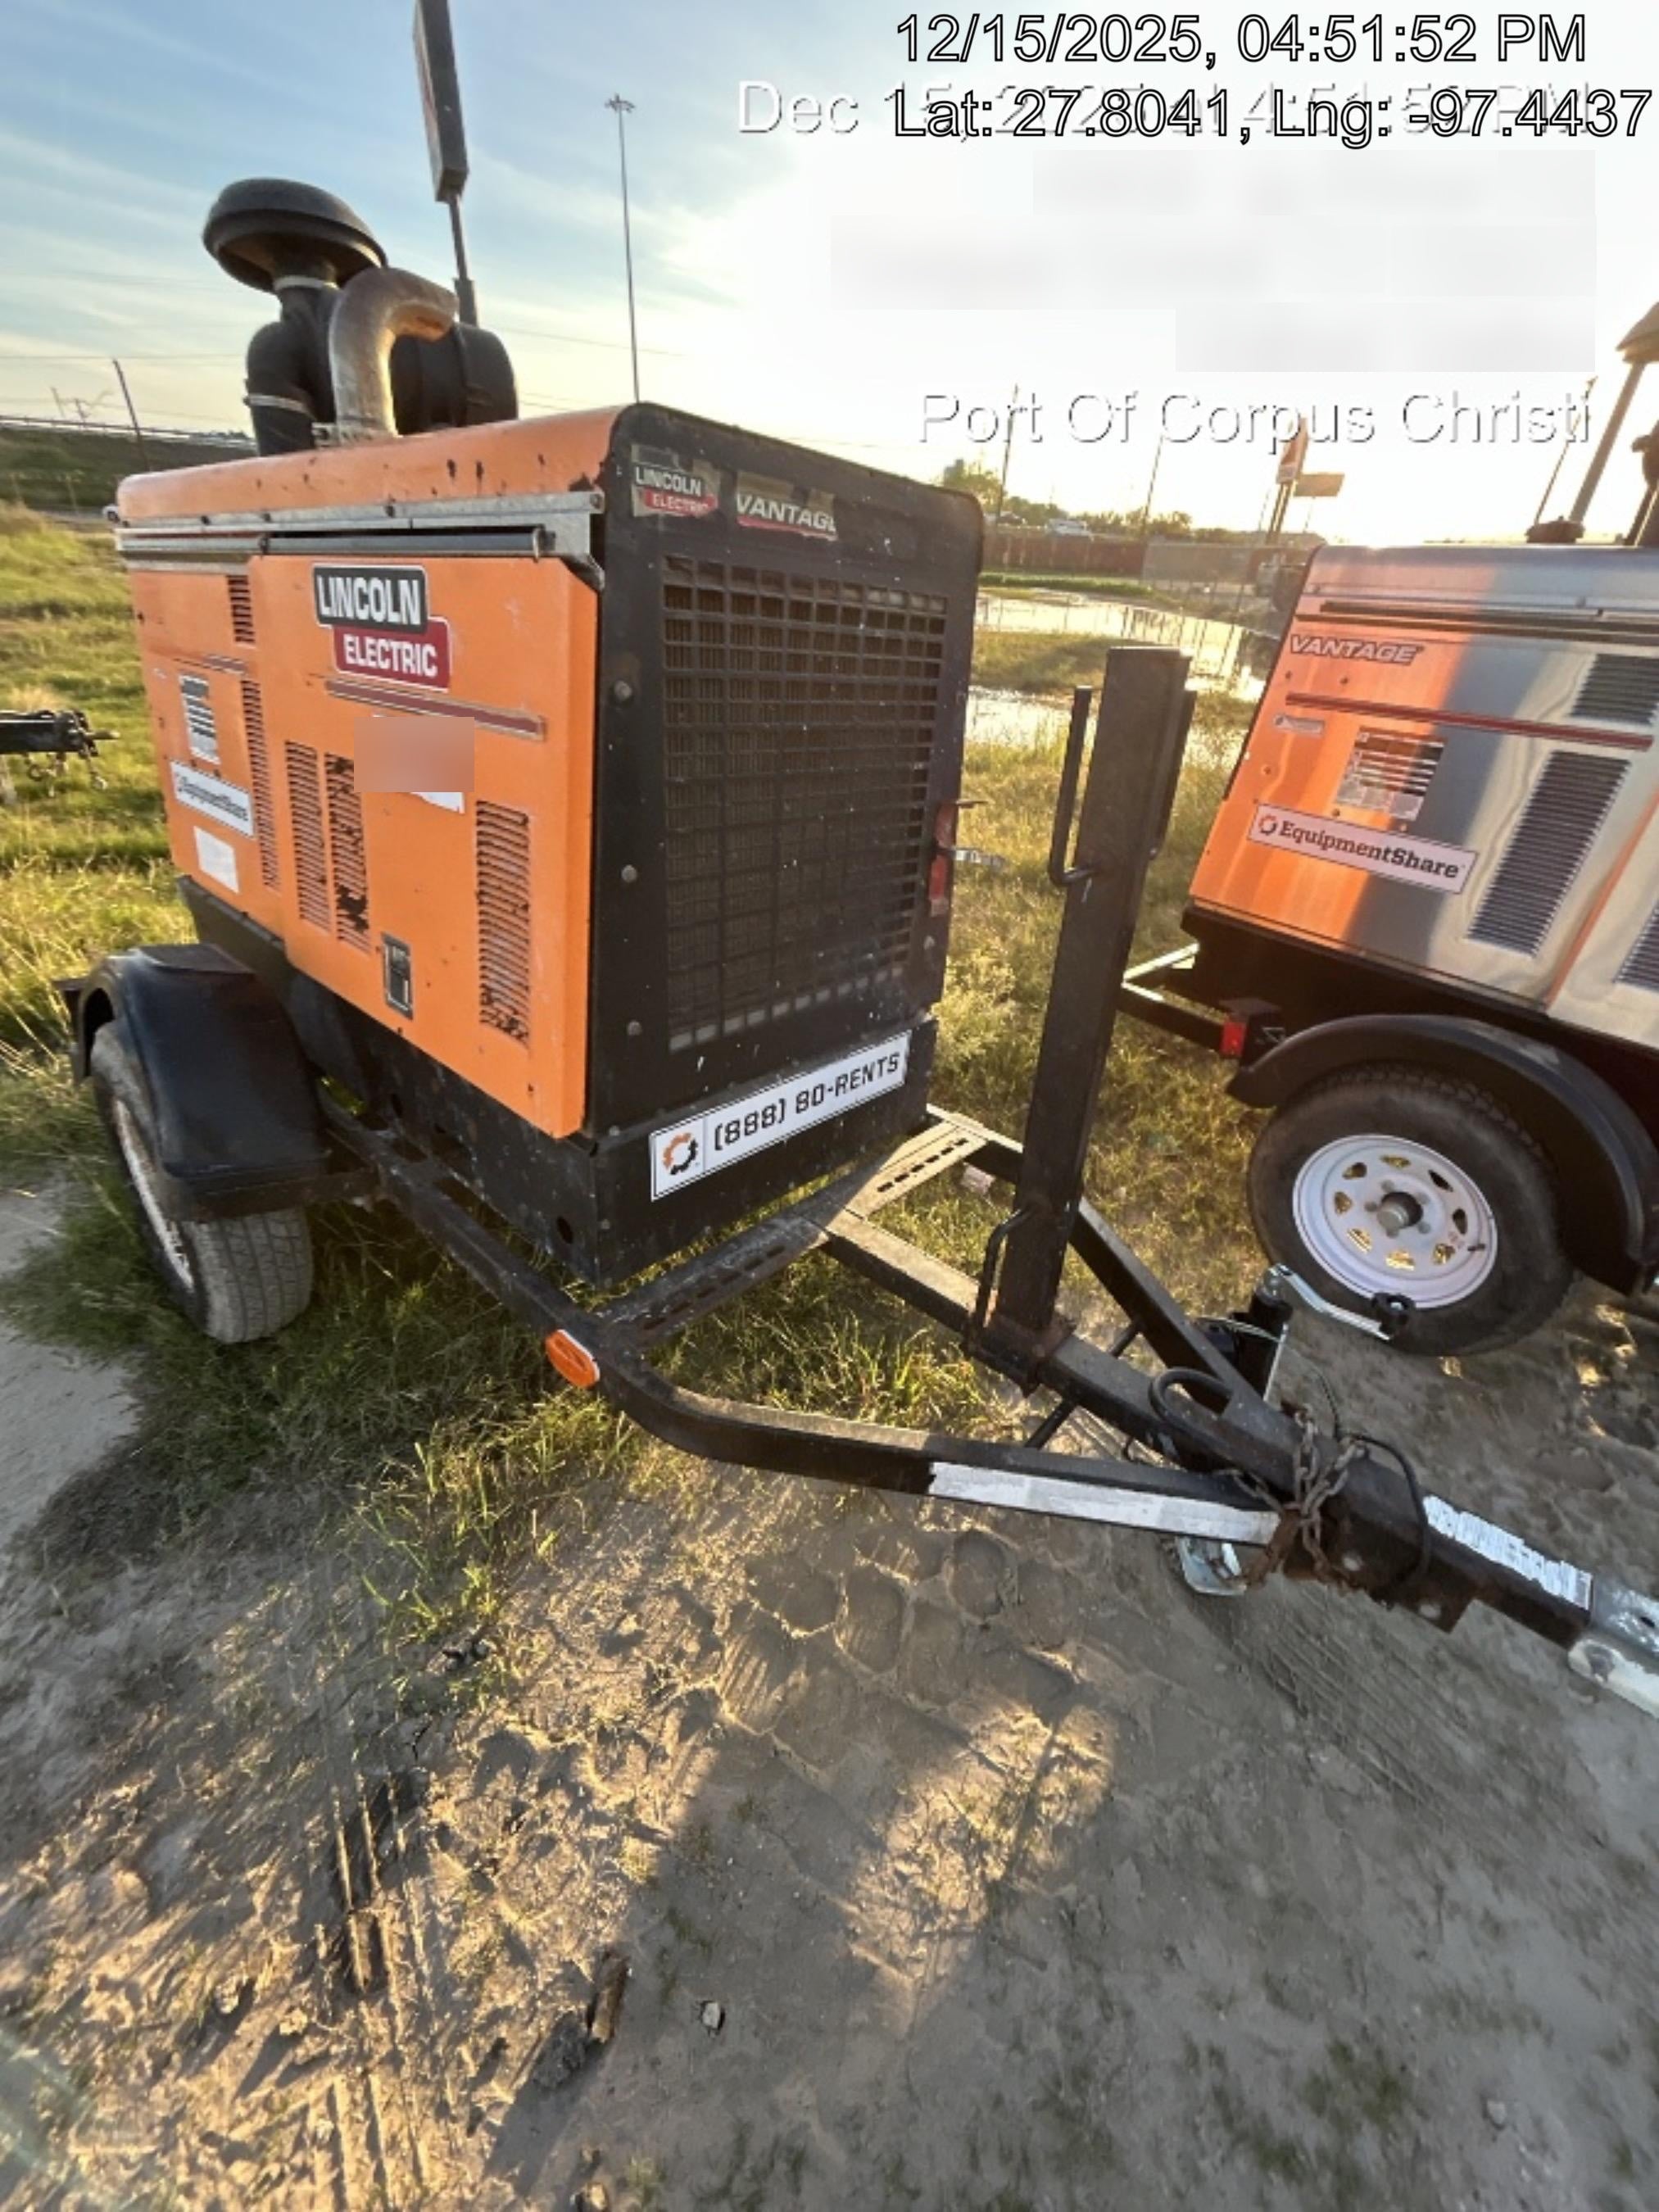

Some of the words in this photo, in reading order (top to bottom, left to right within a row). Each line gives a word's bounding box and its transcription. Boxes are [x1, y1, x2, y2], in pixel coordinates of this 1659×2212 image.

[316, 575, 422, 625] LINCOLN
[342, 634, 438, 678] ELECTRIC
[1290, 634, 1422, 665] VANTAGE
[1279, 819, 1460, 878] EquipmentShare
[713, 1097, 786, 1152] (888)
[795, 1050, 901, 1115] 80-RENTS
